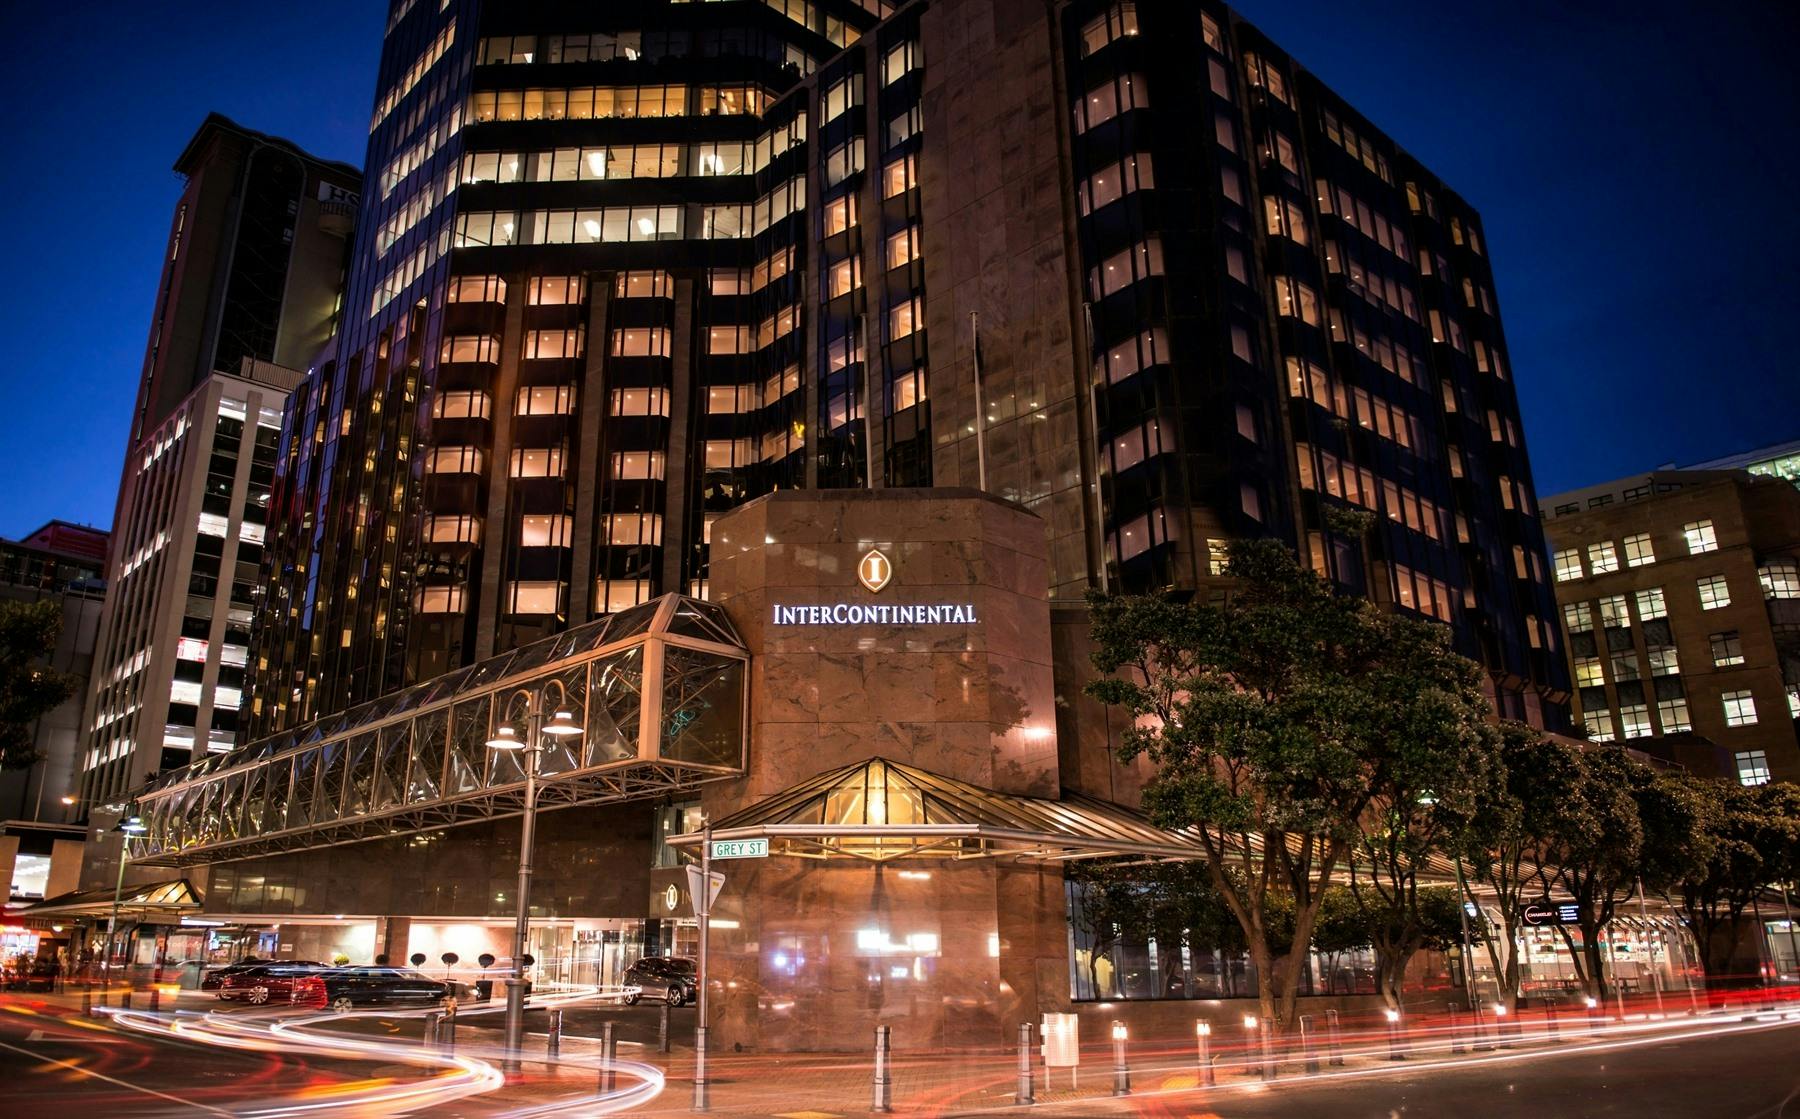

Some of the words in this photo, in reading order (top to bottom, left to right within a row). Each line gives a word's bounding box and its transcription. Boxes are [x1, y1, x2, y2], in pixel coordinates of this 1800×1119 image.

[773, 604, 977, 625] INTERCONTINENTAL
[716, 843, 744, 856] GREY
[749, 842, 762, 854] ST
